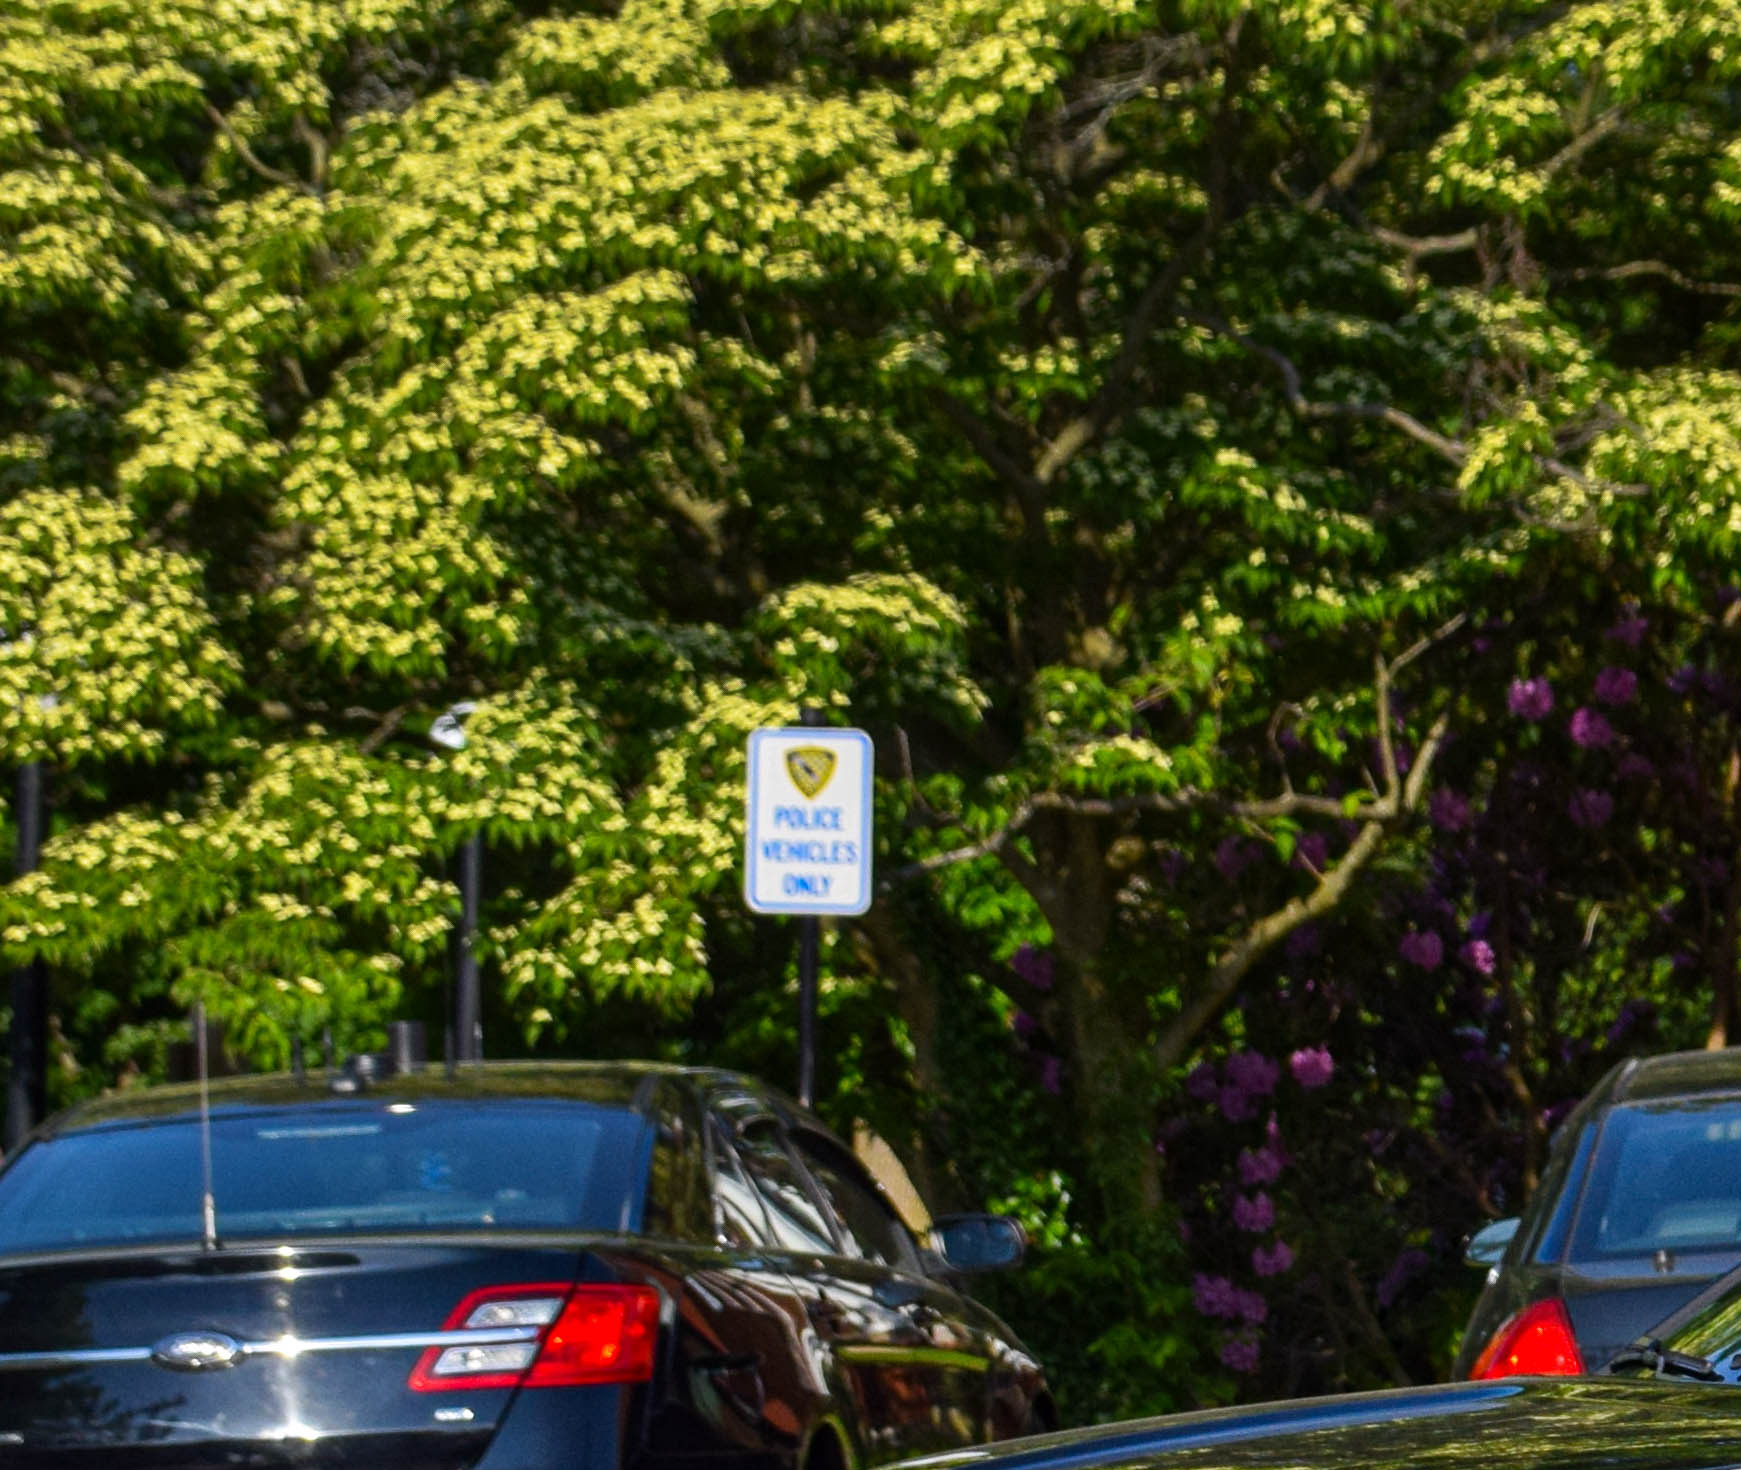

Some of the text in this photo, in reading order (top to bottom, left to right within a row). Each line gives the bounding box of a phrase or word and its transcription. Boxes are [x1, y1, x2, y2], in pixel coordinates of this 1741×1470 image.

[773, 805, 842, 830] POLICE
[762, 840, 859, 864] VEHICLES
[782, 874, 832, 897] ONLY
